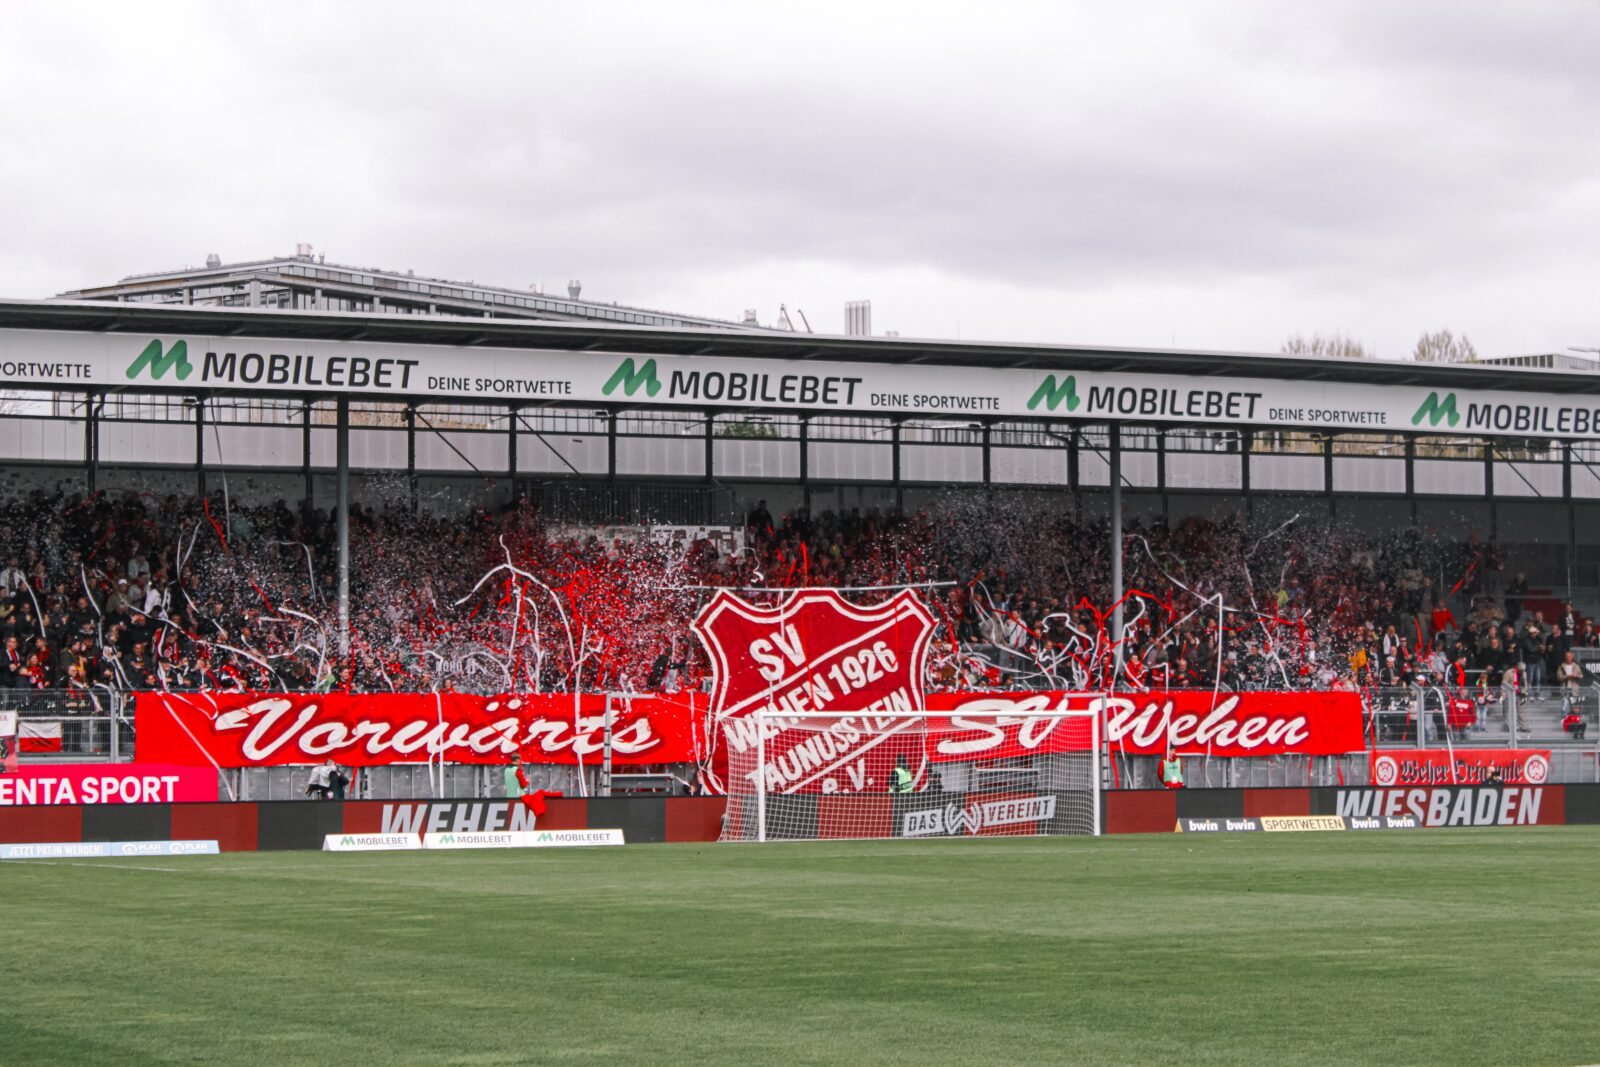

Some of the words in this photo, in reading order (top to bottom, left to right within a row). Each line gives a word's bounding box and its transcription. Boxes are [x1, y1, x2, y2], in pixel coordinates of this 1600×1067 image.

[0, 362, 92, 378] ORTWETTE
[201, 352, 419, 389] MOBILEBET
[428, 376, 470, 392] DEINE
[475, 378, 572, 395] SPORTWETTE
[668, 370, 862, 406] MOBILEBET
[870, 393, 909, 407] DEINE
[913, 394, 999, 410] SPORTWETTE
[1087, 386, 1262, 419] MOBILEBET
[1269, 408, 1304, 422] DEINE
[1308, 409, 1387, 425] SPORTWETTE
[750, 624, 807, 682] SV
[828, 640, 899, 696] 1926
[215, 698, 661, 761] Vorwärts
[937, 695, 1068, 754] SV
[1089, 694, 1309, 749] Wehen
[81, 775, 180, 804] SPORT
[380, 803, 537, 834] WEHEN
[908, 813, 938, 832] DAS
[987, 800, 1051, 822] VEREINT
[1189, 815, 1219, 831] bwin
[1226, 815, 1256, 831] bwin
[1265, 816, 1343, 831] SPORTWETTEN
[1351, 816, 1380, 829] bwin
[1386, 815, 1415, 829] bwin
[1335, 788, 1543, 827] WIESBADEN
[357, 837, 409, 846] MOBILEBET
[456, 834, 512, 844] MOBILEBET
[555, 833, 611, 842] MOBILEBET
